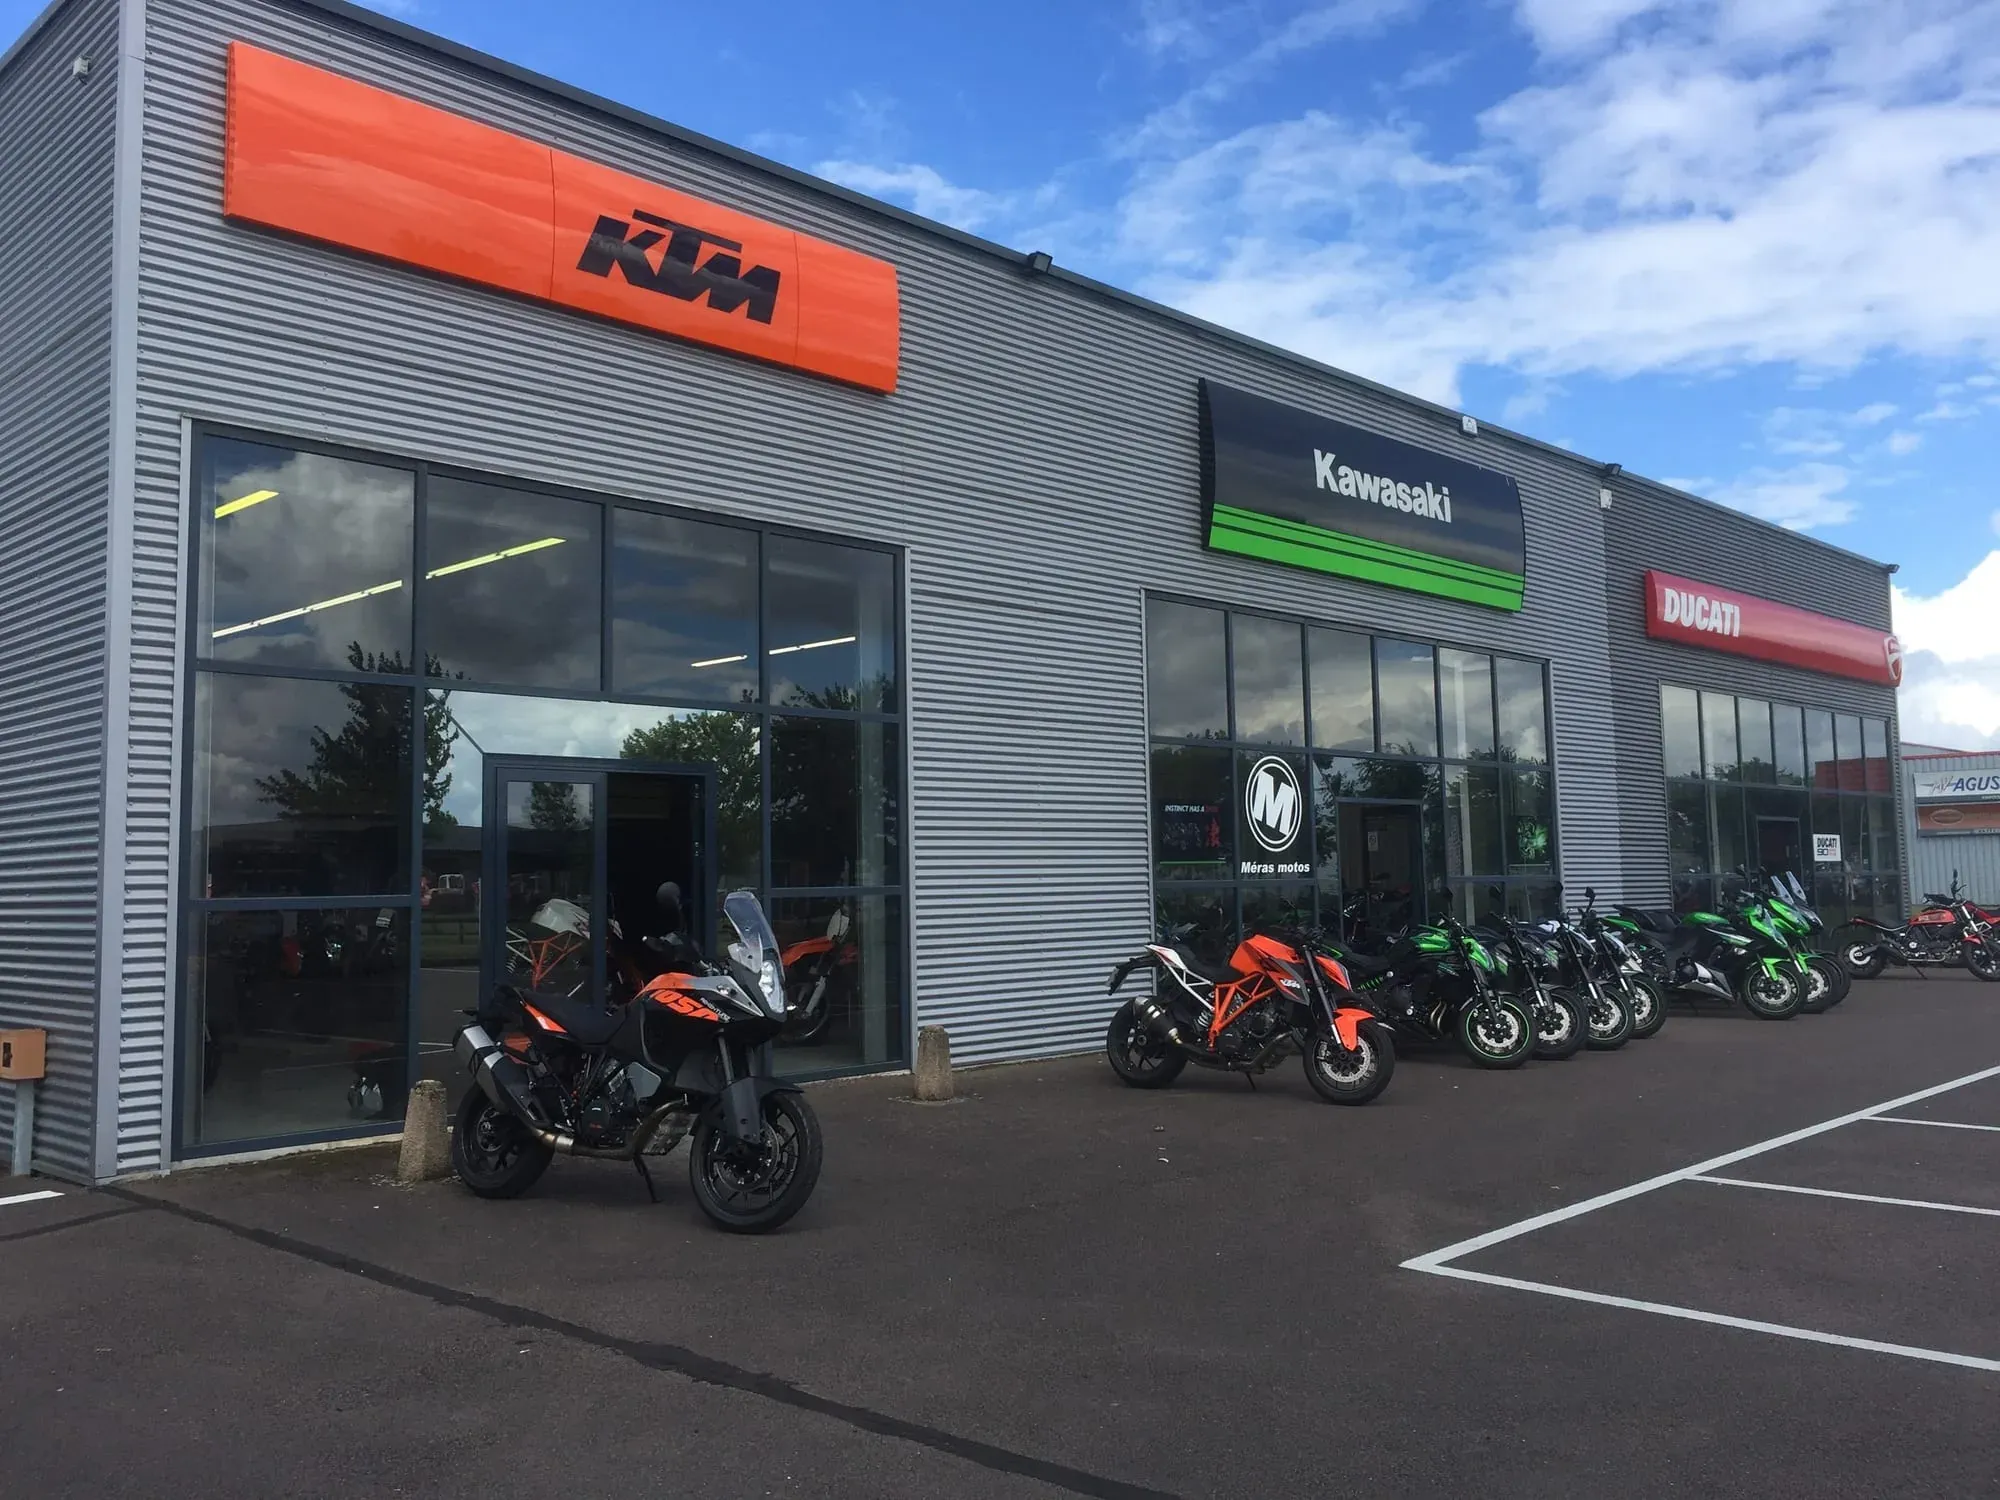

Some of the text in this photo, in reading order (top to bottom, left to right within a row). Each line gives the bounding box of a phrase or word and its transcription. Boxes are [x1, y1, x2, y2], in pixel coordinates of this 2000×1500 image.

[576, 209, 781, 325] KTM
[1313, 448, 1452, 523] Kawasaki
[1663, 587, 1741, 638] DUCATI
[1253, 769, 1296, 836] M
[1241, 861, 1310, 874] Méras motos
